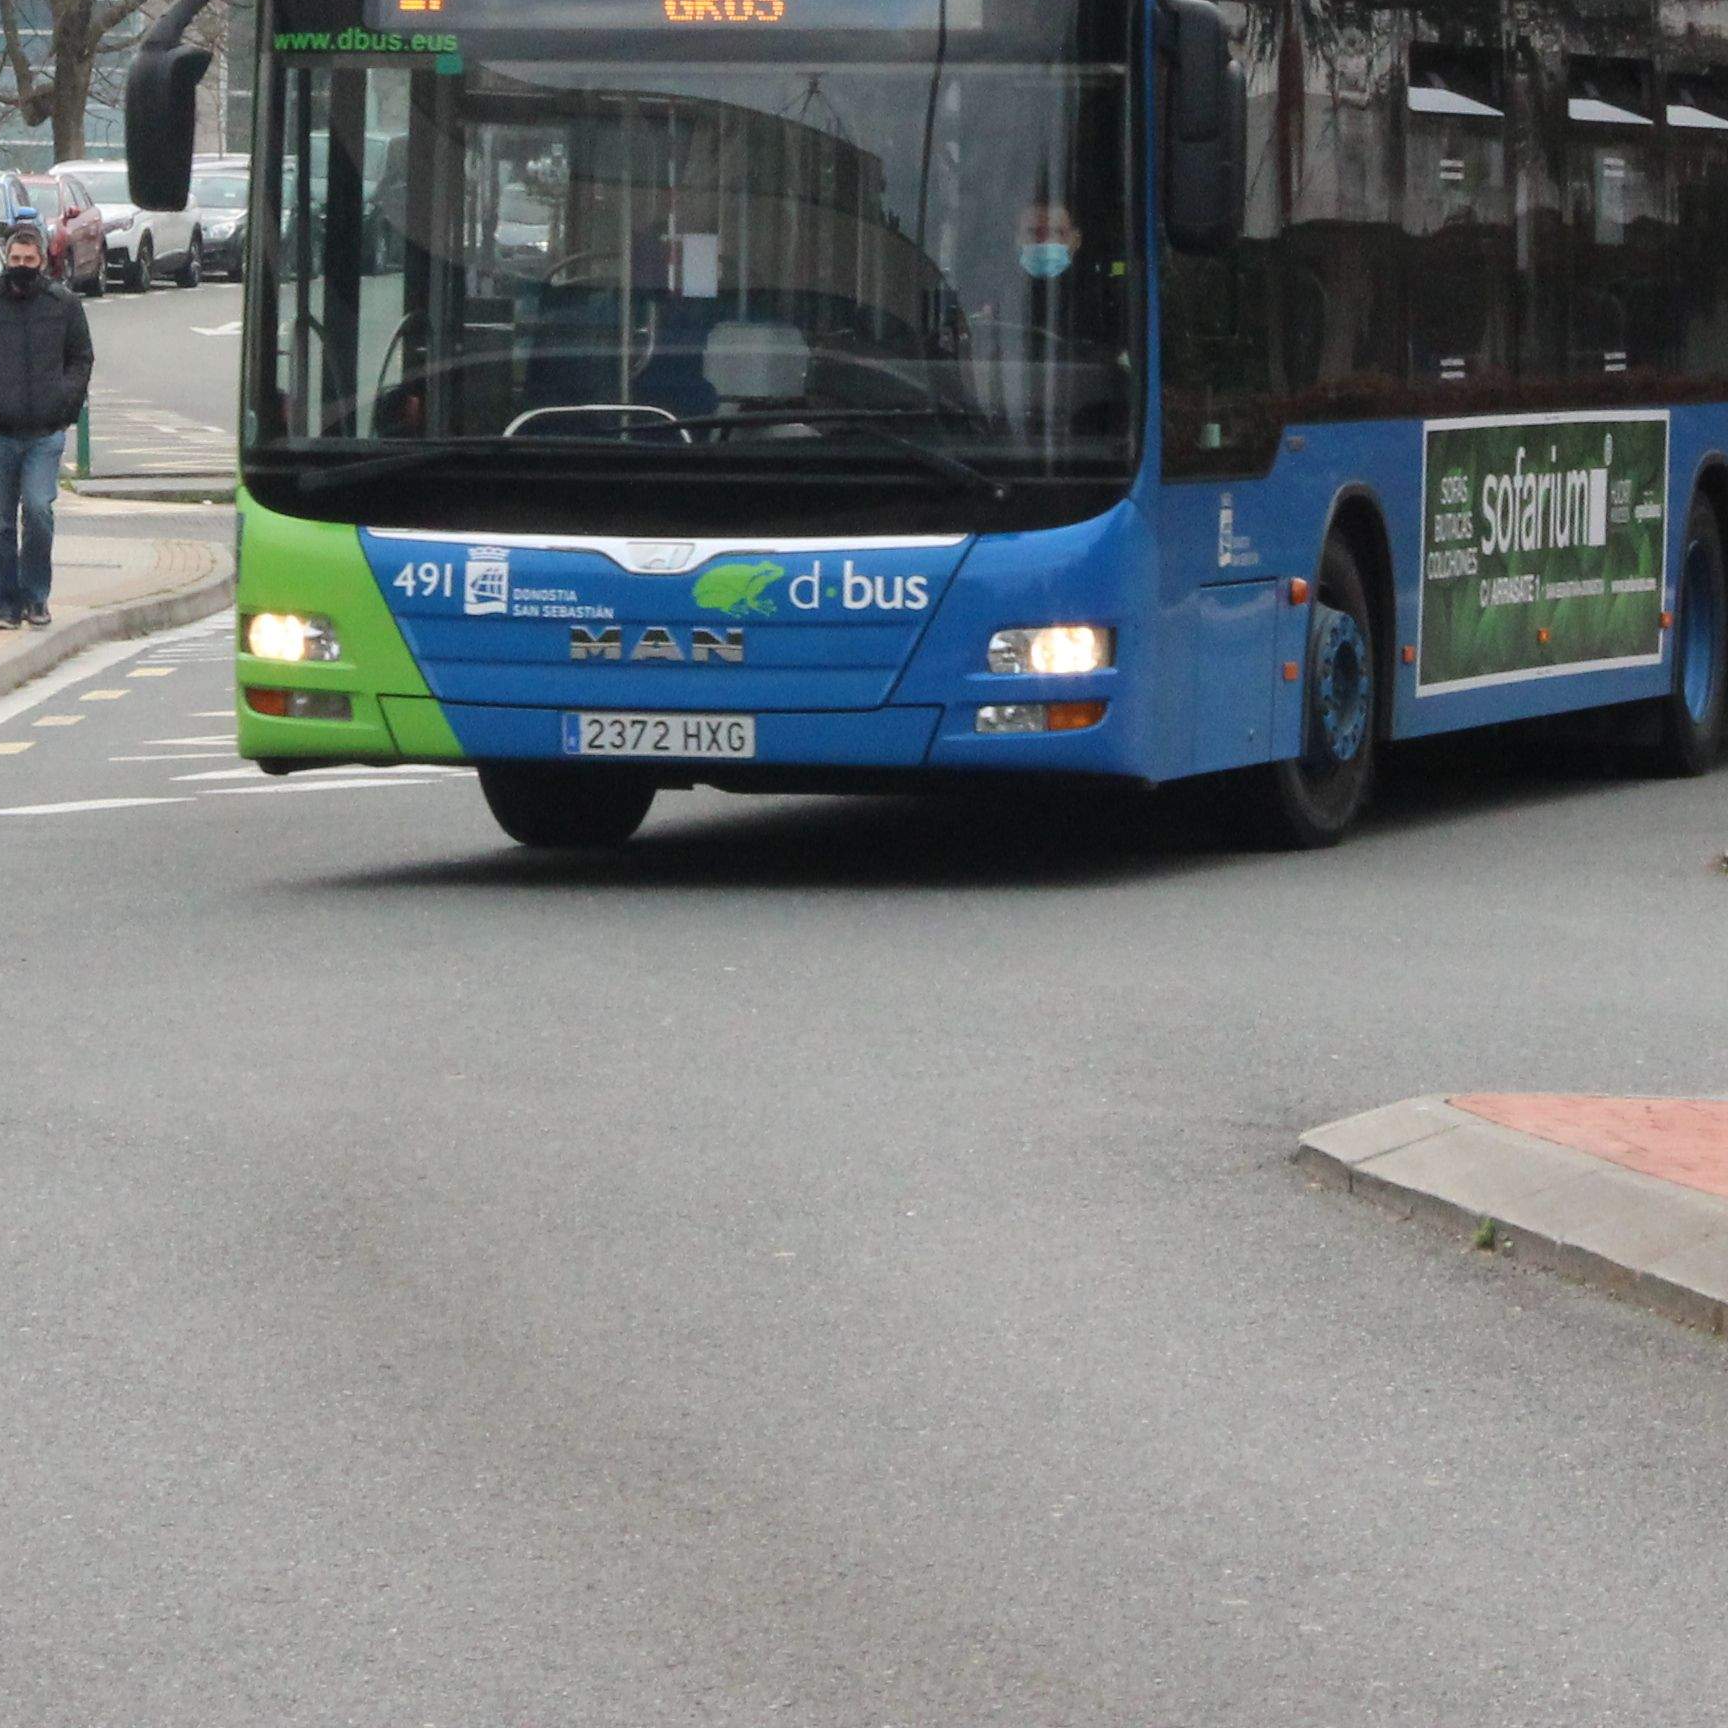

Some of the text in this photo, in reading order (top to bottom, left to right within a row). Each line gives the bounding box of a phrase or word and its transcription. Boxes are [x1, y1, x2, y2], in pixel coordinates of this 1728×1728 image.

[273, 27, 459, 52] www.dbus.eus
[1480, 445, 1590, 556] sofarium
[393, 562, 453, 598] 491
[512, 587, 578, 602] DONOSTIA
[512, 604, 540, 617] SAN
[569, 625, 744, 662] MAN
[587, 719, 746, 752] 2372 HXG
